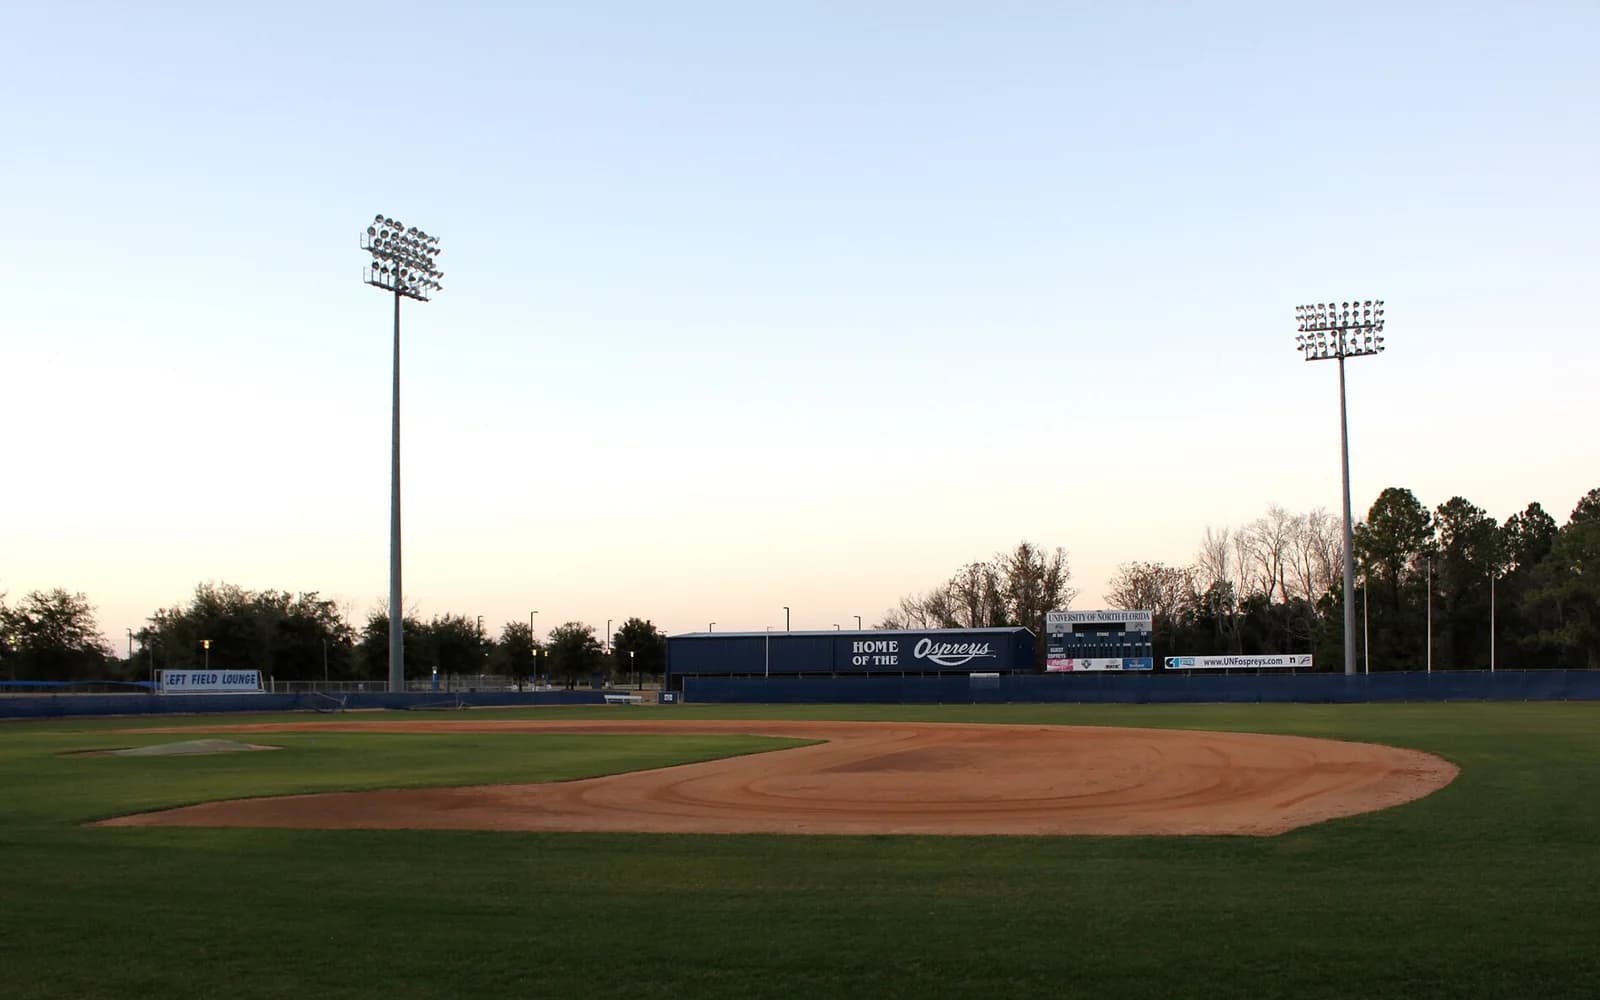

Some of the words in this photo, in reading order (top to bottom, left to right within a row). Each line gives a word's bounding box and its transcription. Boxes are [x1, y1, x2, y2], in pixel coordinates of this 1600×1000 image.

[1048, 613, 1085, 622] UNIVERSITY
[1087, 613, 1096, 621] OF
[1097, 612, 1120, 621] NORTH
[1121, 612, 1150, 621] FLORIDA
[853, 641, 898, 653] HOME
[914, 638, 992, 666] Ospreys
[852, 655, 869, 666] OF
[872, 655, 898, 665] THE
[1203, 657, 1283, 667] www.UNFospreys.com
[191, 674, 218, 685] FIELD
[222, 673, 256, 685] LOUNGE
